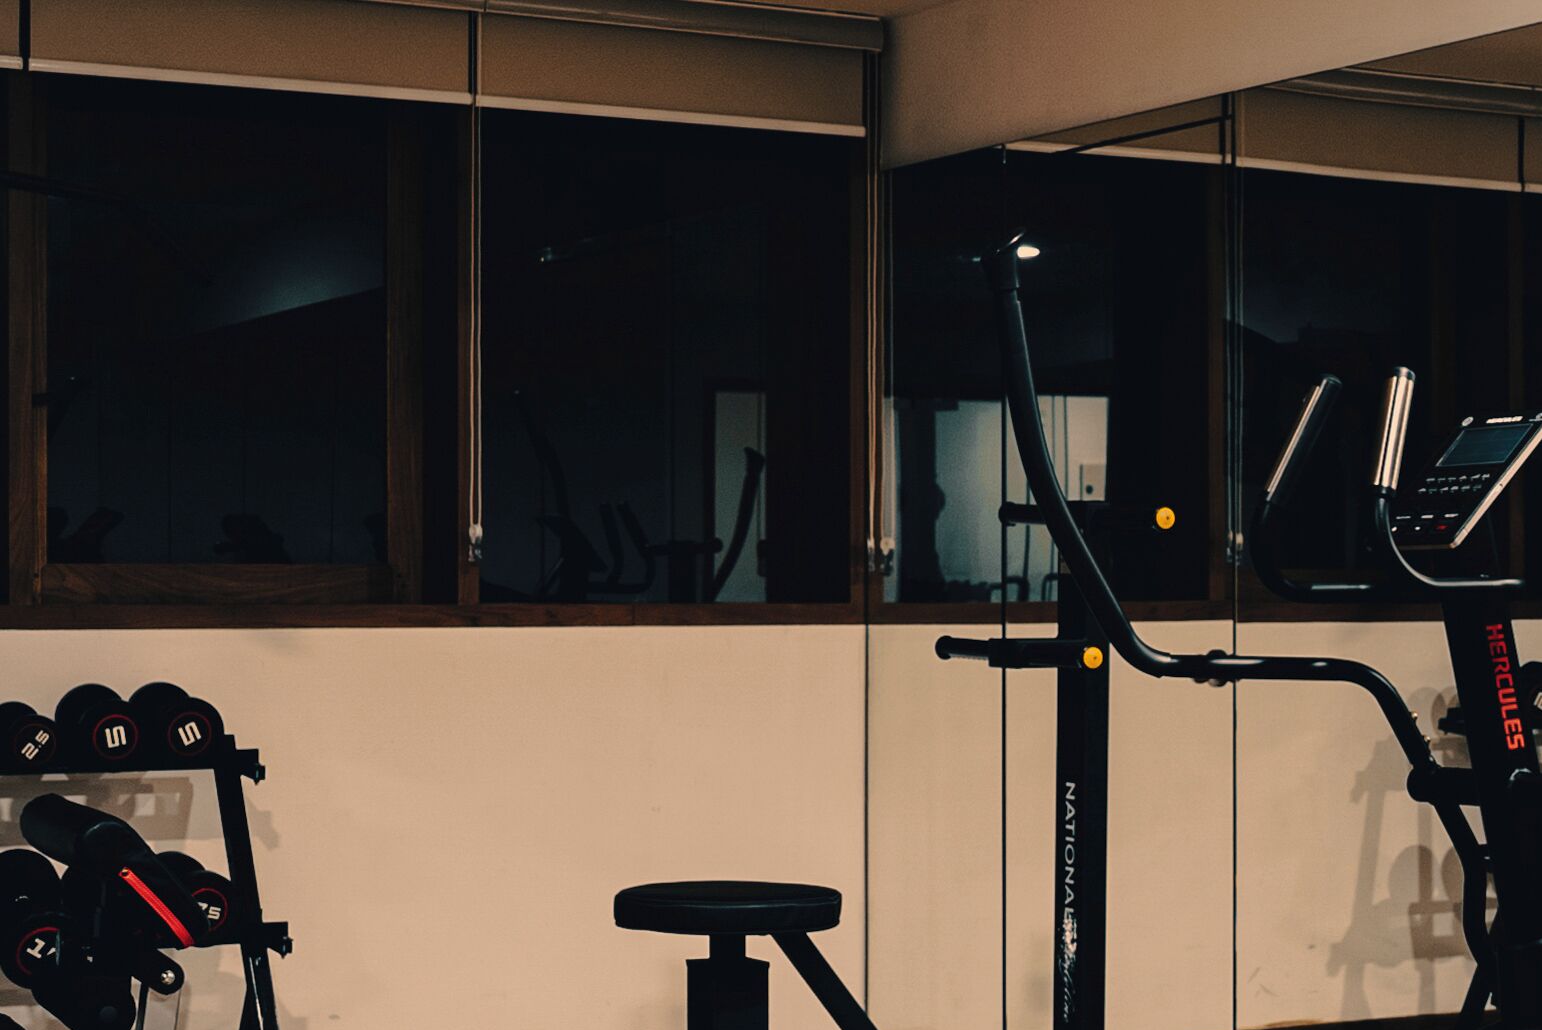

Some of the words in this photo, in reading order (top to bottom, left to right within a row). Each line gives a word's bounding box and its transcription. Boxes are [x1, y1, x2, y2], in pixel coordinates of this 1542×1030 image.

[20, 729, 51, 761] 2.5
[1486, 623, 1526, 753] HERCULES
[1064, 781, 1077, 920] NATIONAL
